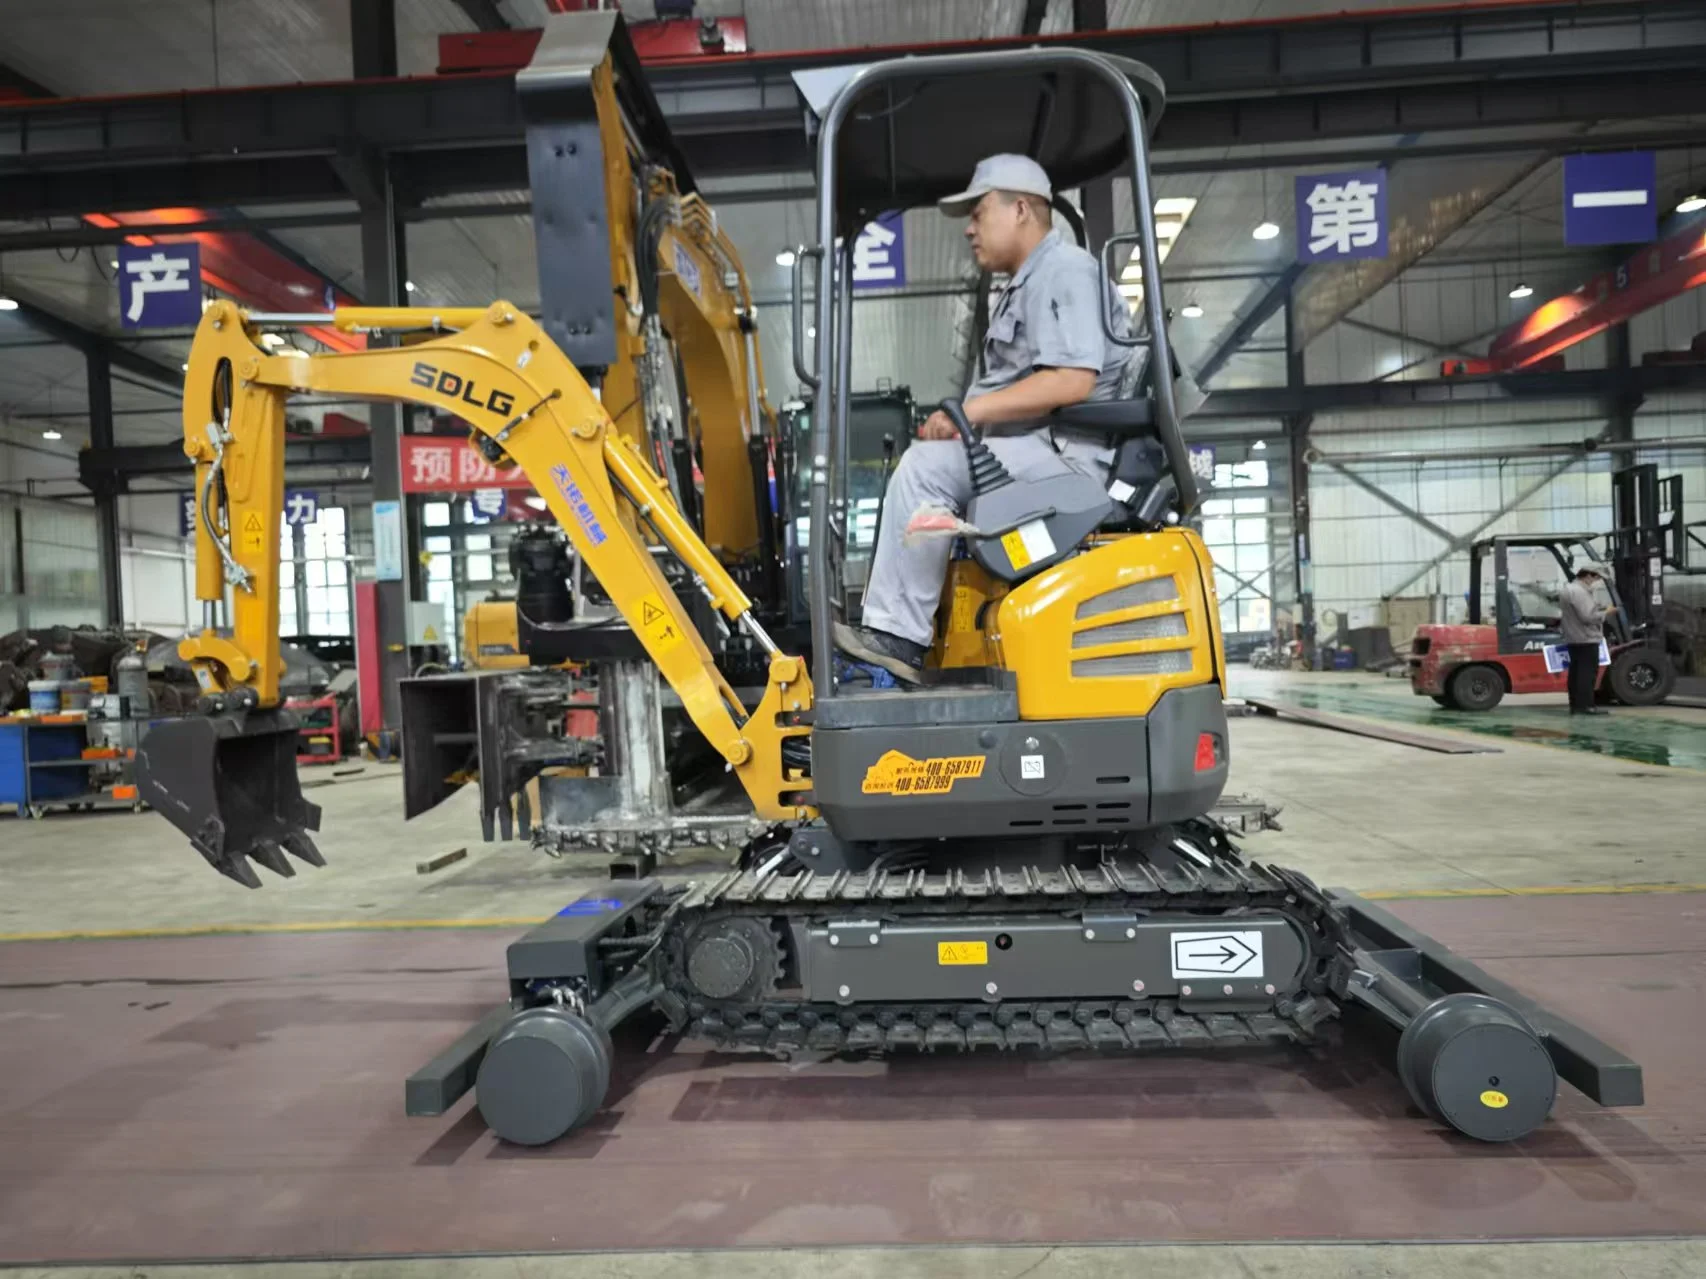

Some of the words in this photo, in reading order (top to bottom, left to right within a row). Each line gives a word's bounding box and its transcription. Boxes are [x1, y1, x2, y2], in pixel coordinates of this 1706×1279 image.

[1572, 189, 1648, 208] 一
[1305, 180, 1379, 254] 第
[126, 253, 190, 322] 产
[410, 362, 515, 417] SDLG
[287, 494, 316, 524] 力
[926, 760, 982, 776] 400-6587911
[895, 776, 951, 792] 400-6587999
